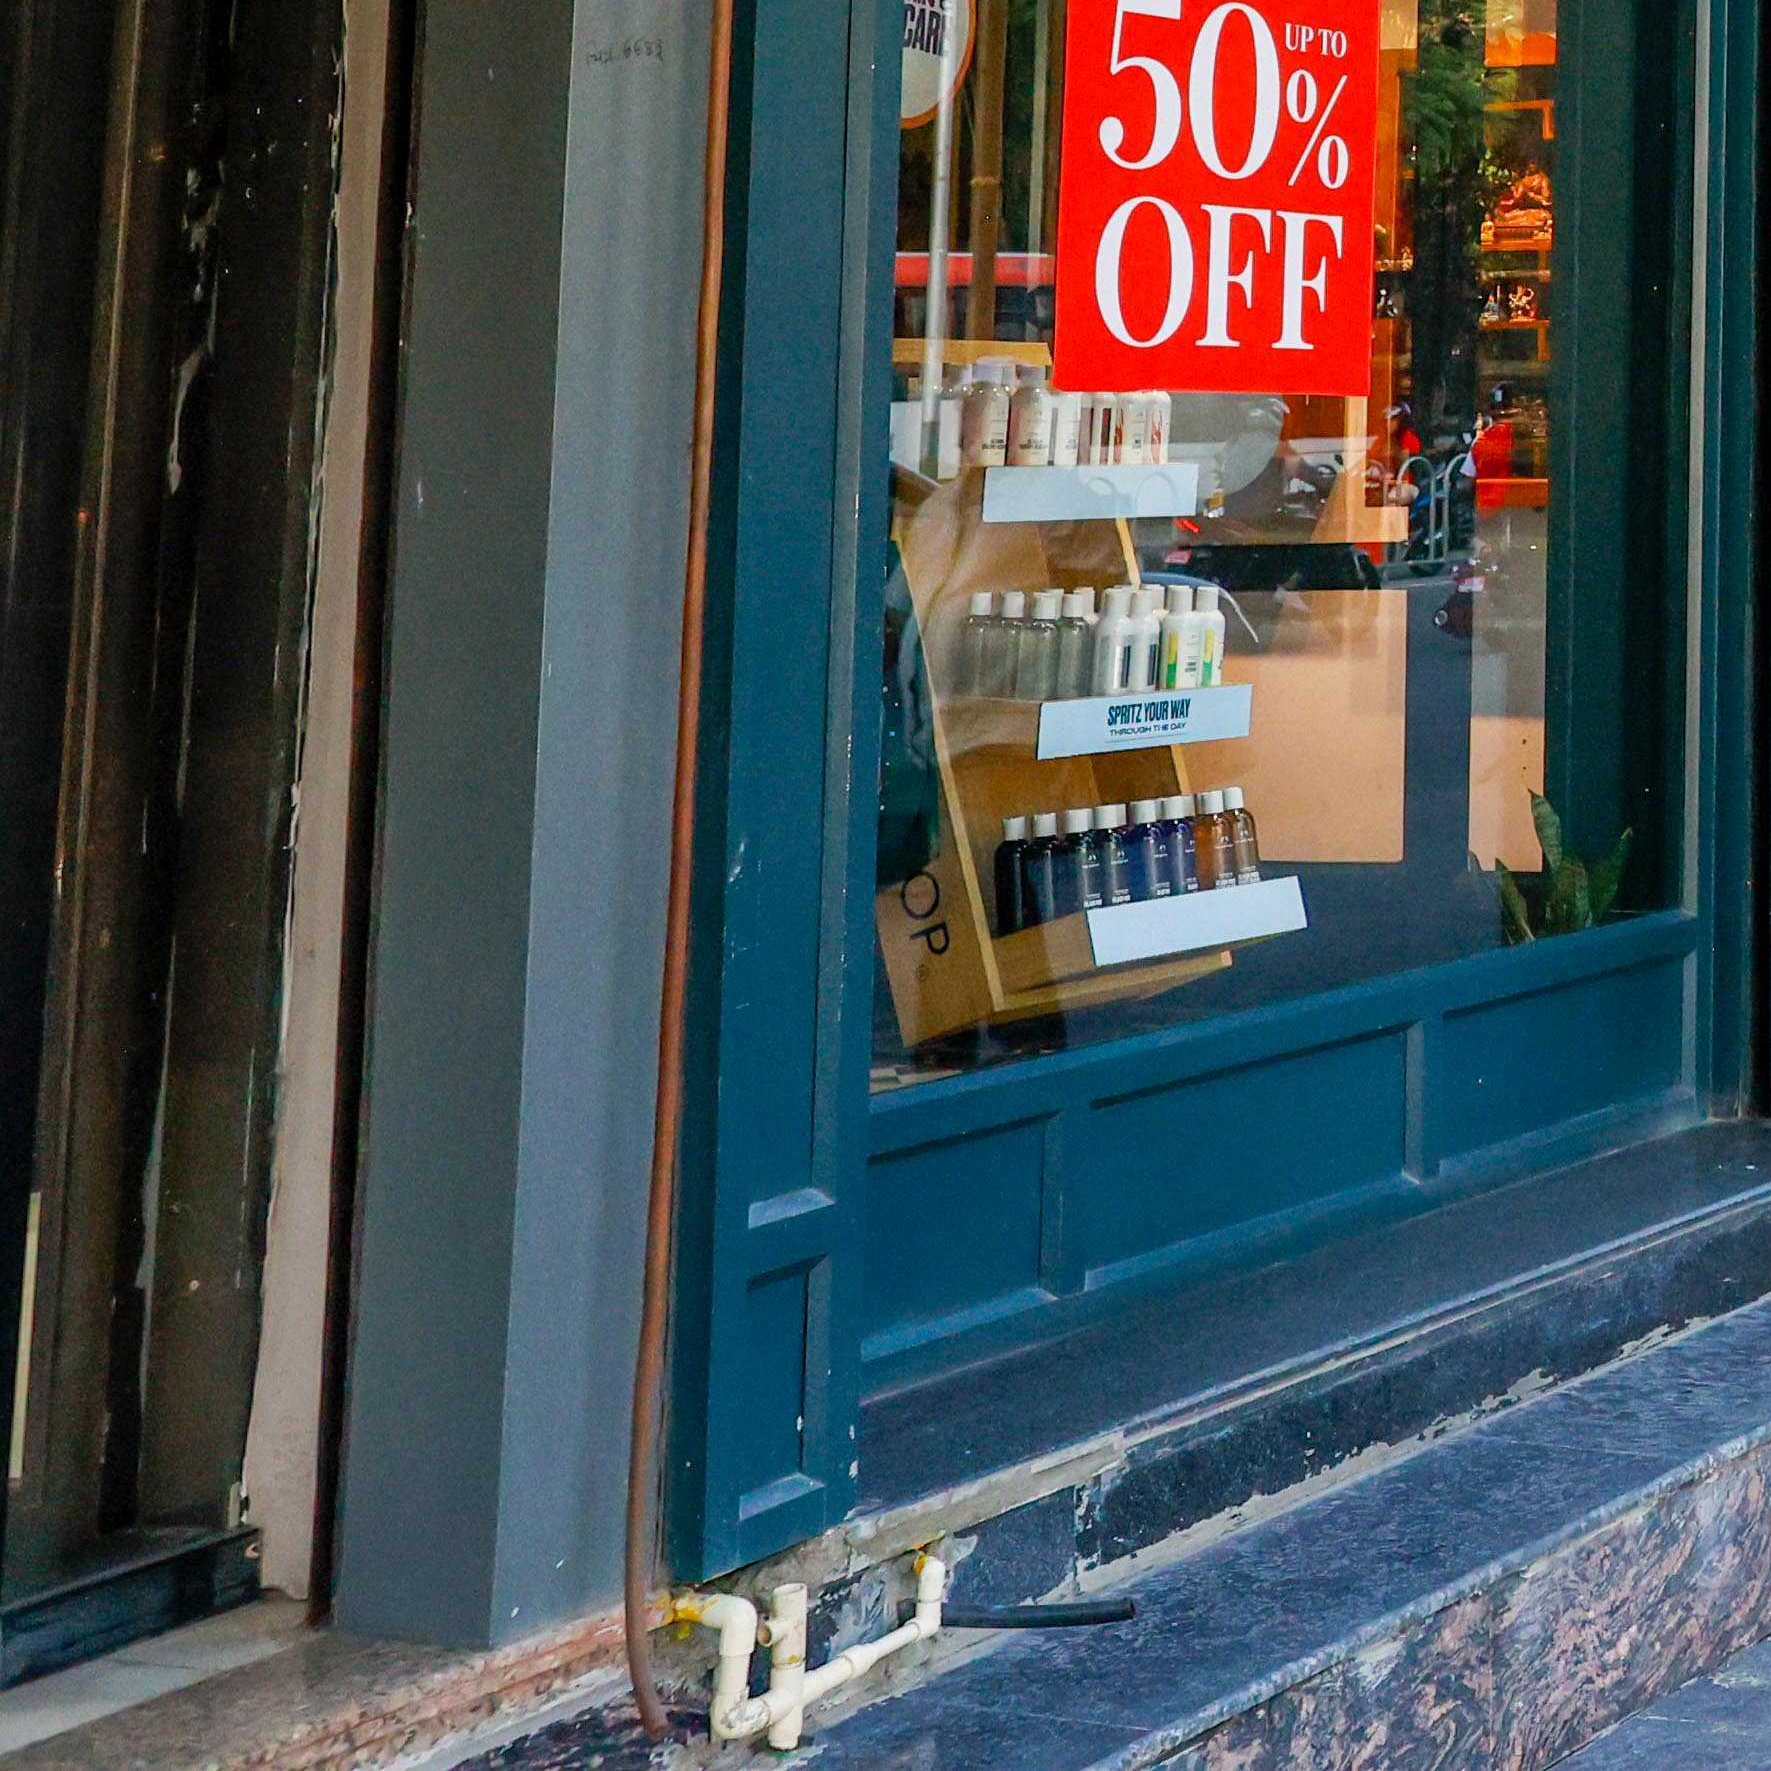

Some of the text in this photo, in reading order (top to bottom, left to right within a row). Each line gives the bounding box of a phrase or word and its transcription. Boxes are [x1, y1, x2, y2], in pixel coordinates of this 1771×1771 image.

[1285, 23, 1347, 58] UP TO
[1095, 196, 1343, 350] OFF
[1107, 698, 1192, 726] SPRITZ YOUR WAY
[1170, 722, 1187, 731] DAY
